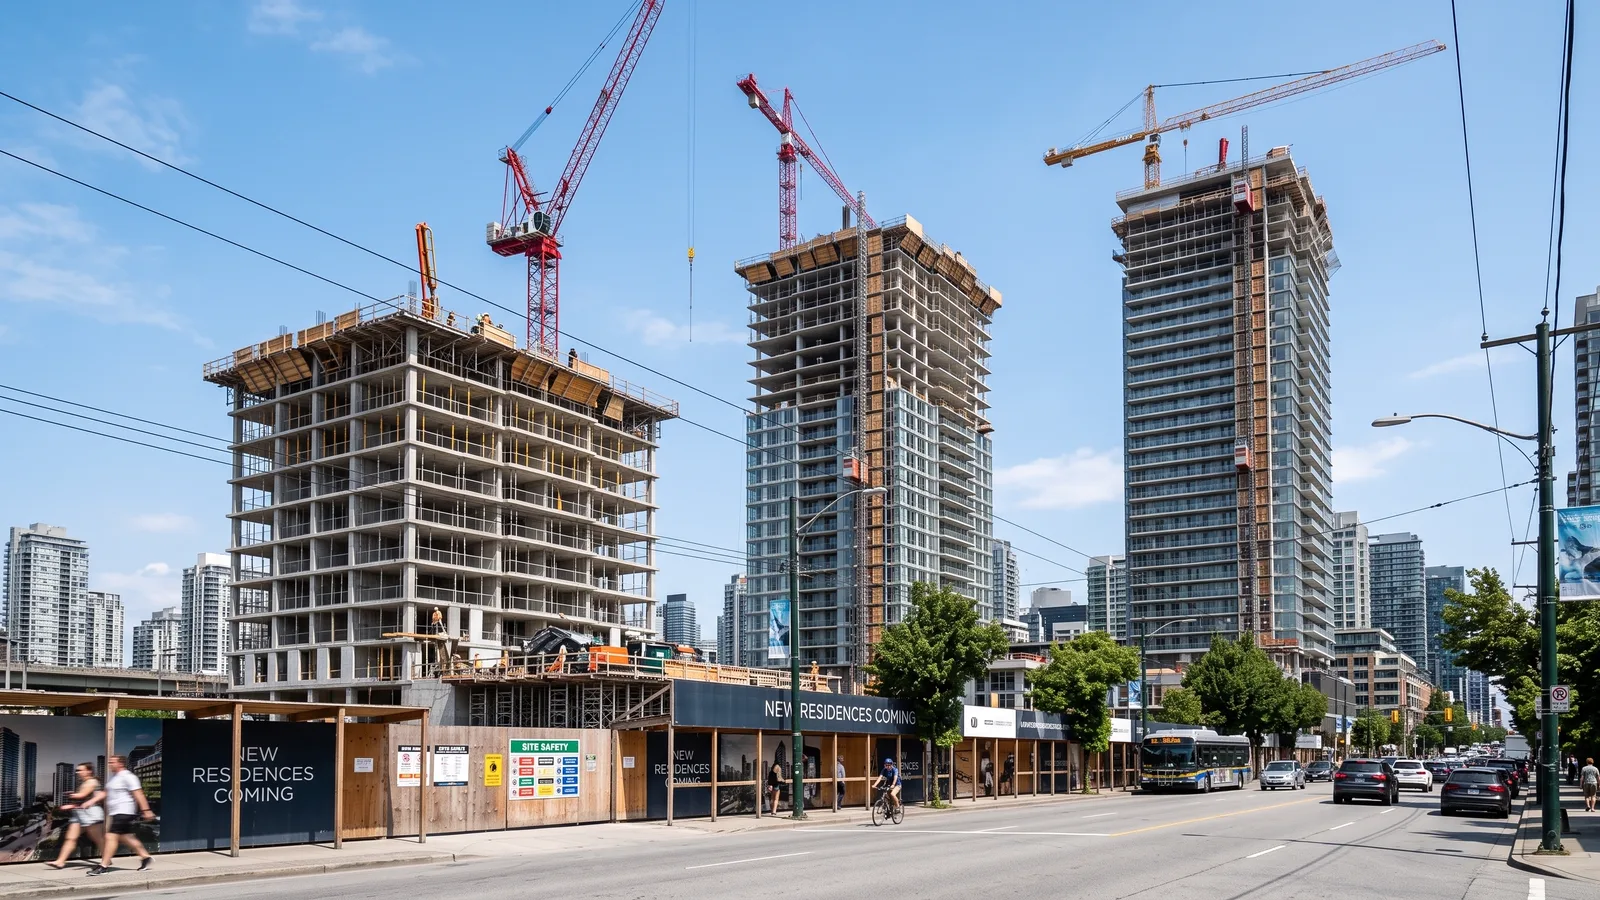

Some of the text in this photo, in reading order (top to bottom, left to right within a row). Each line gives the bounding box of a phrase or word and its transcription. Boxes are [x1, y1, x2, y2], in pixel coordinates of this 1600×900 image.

[765, 700, 916, 725] NEW RESIDENCES COMING
[522, 742, 568, 751] SITE SAFETY
[193, 766, 314, 782] RESDENCES
[654, 763, 710, 775] REDENCES
